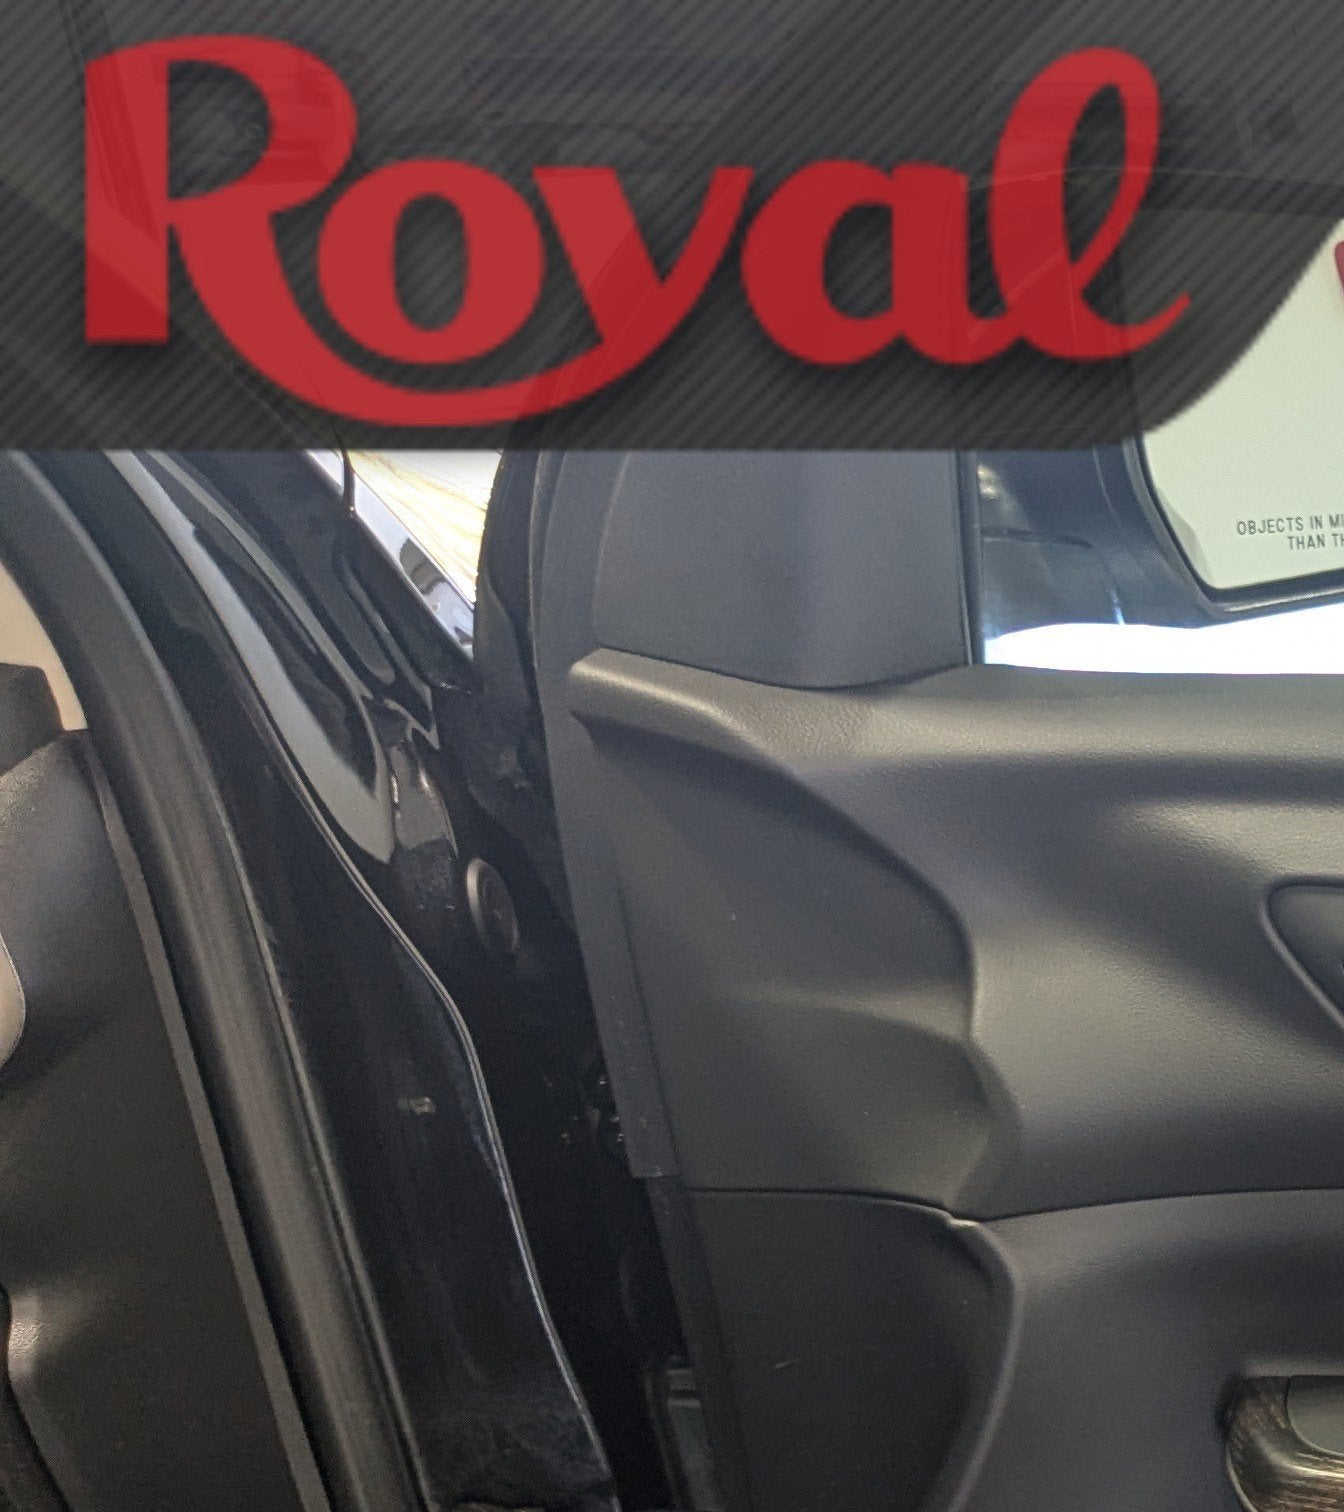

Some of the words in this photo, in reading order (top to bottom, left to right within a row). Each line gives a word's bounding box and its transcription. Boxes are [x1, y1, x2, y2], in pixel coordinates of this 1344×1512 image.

[1237, 516, 1304, 536] OBJECTS
[1310, 515, 1323, 530] IN
[1287, 534, 1326, 550] THAN
